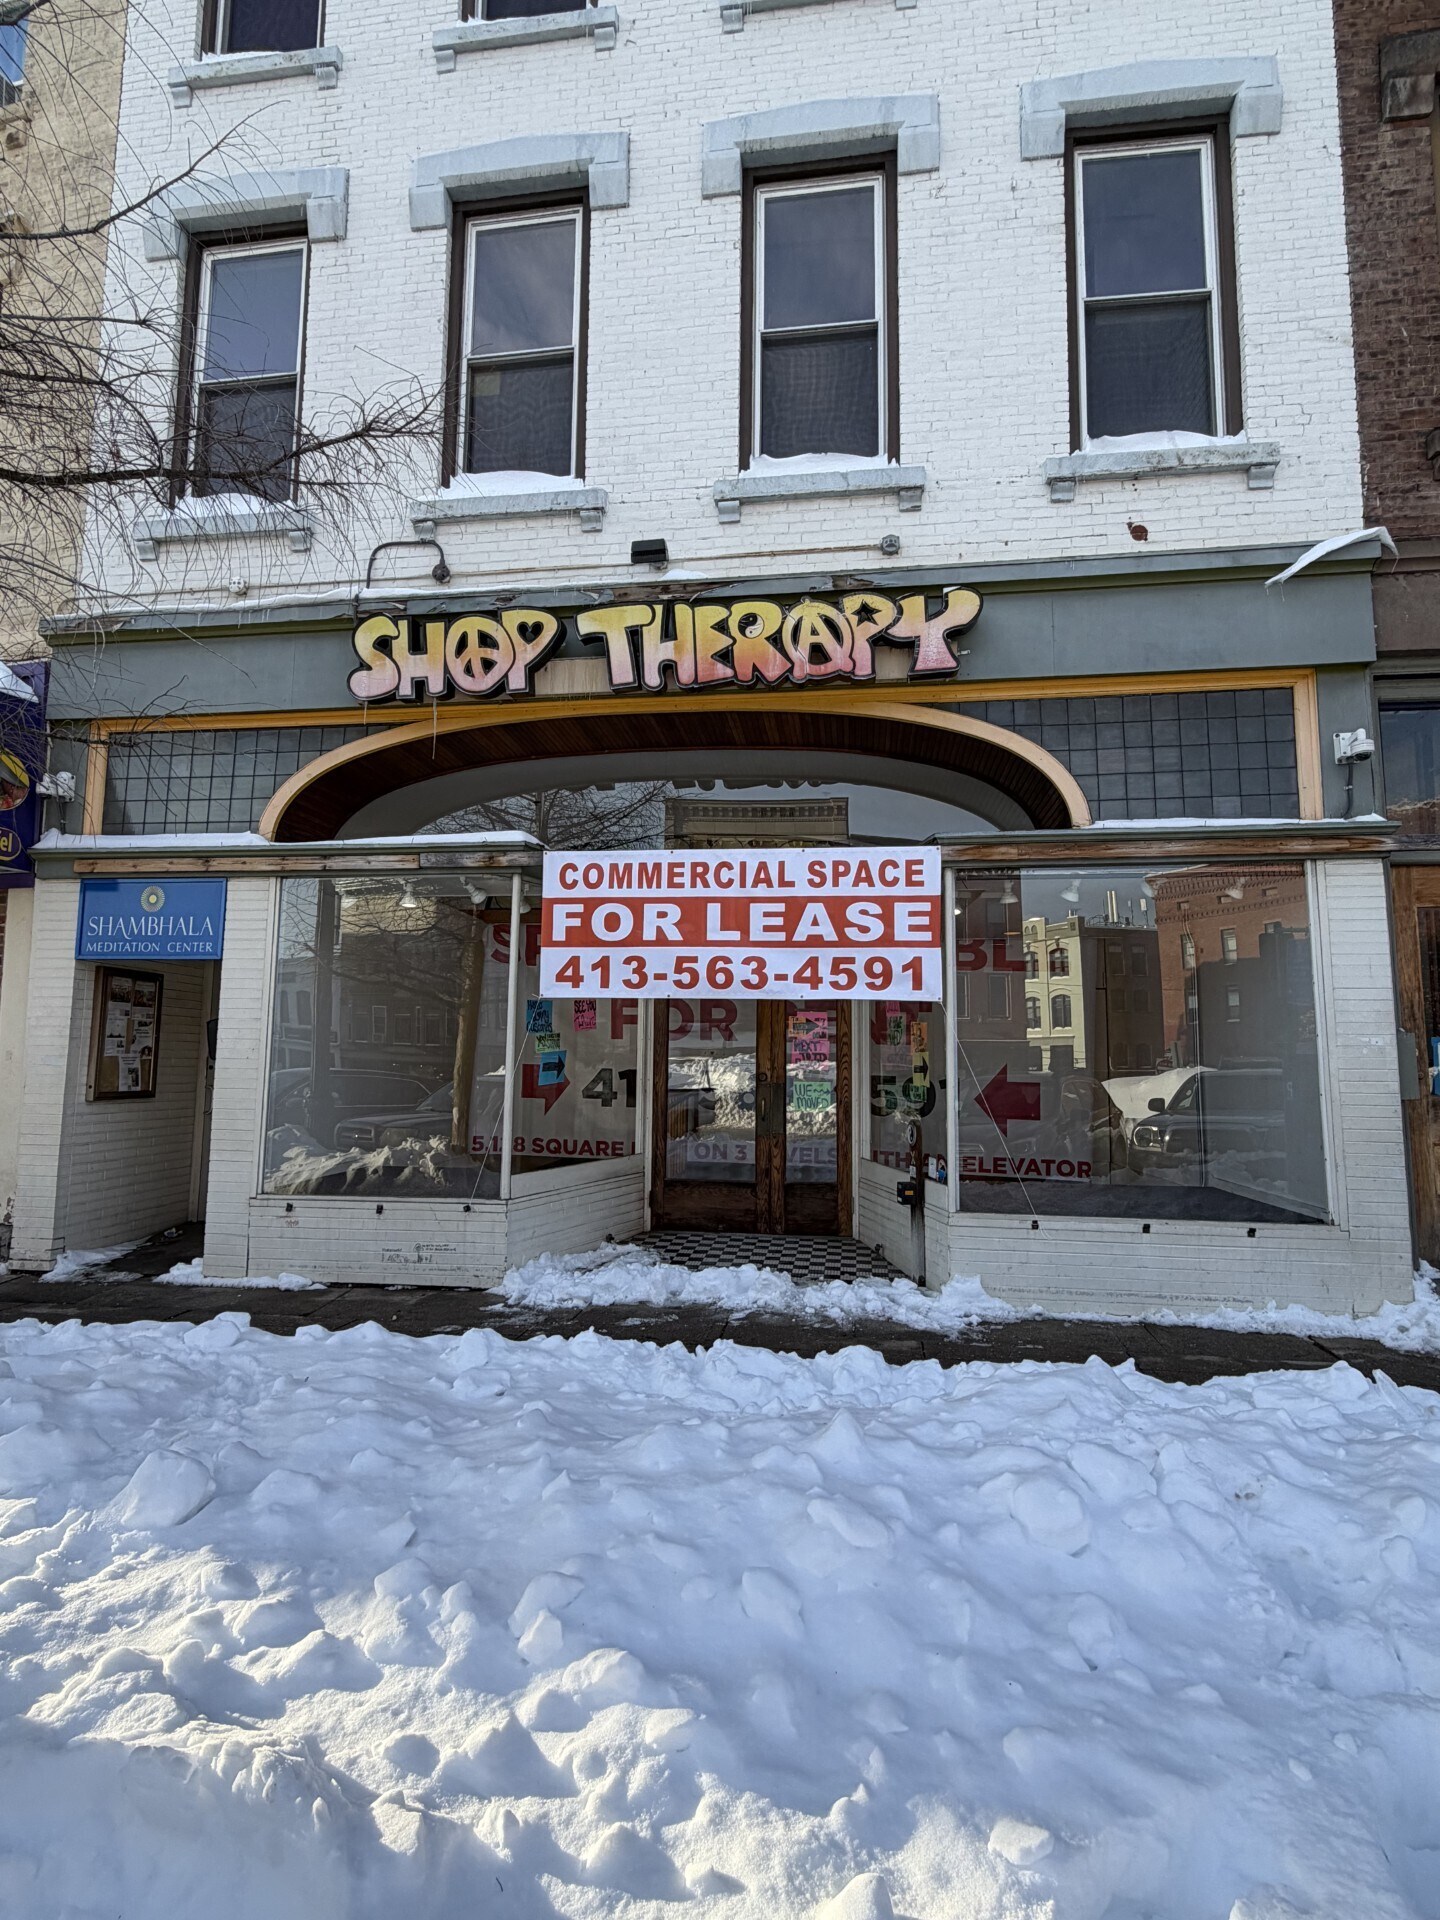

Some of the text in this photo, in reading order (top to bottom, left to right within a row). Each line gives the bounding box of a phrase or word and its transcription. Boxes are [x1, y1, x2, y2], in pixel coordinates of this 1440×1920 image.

[347, 586, 983, 700] SHOP THERAPY
[559, 859, 925, 890] COMMERCIAL SPACE
[87, 916, 214, 939] SHAMBHALA
[552, 902, 932, 942] FOR LEASE
[86, 942, 213, 952] MEDITATION CENTER
[555, 955, 923, 991] 413-563-4591
[795, 1084, 813, 1097] WE
[796, 1097, 829, 1110] MOVED
[532, 1137, 624, 1157] SQUARE
[693, 1143, 728, 1160] ON
[734, 1144, 748, 1161] 3
[963, 1156, 1092, 1178] ELEVATOR
